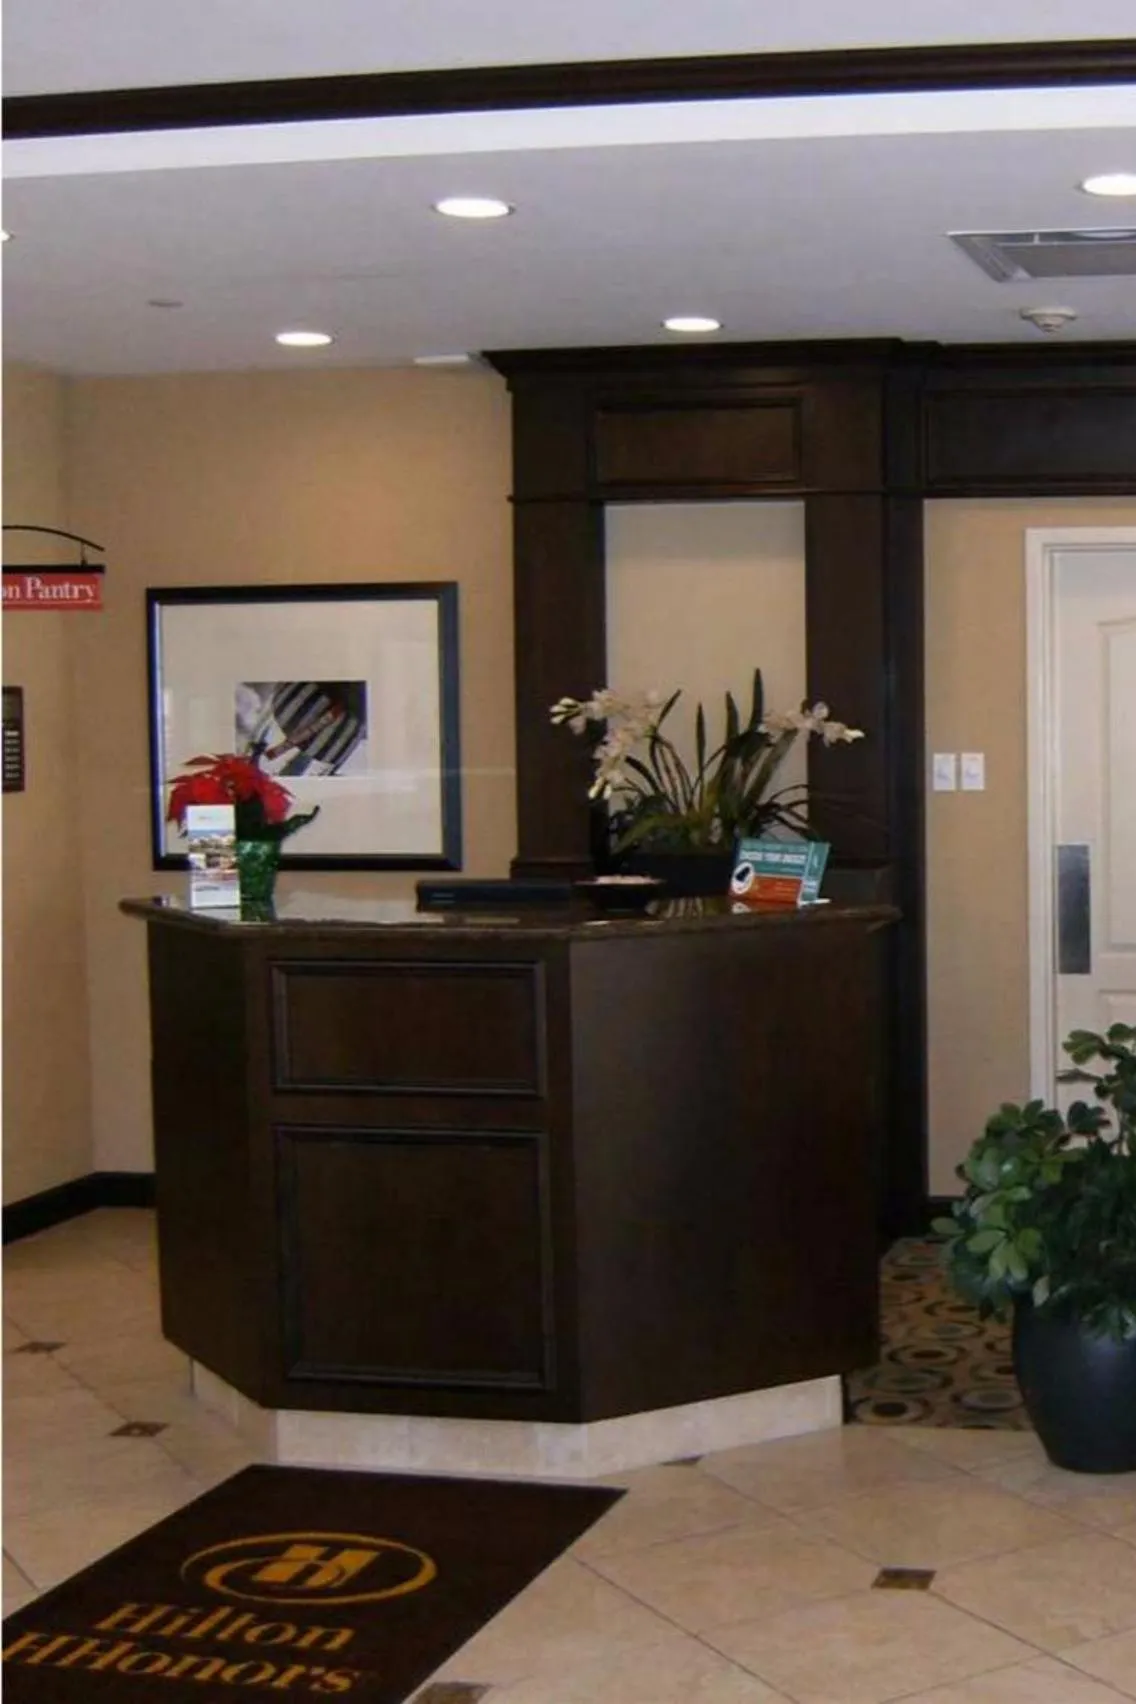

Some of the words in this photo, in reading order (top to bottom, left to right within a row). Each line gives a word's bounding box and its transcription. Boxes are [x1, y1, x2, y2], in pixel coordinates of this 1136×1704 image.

[26, 576, 95, 603] Pantry
[95, 1602, 355, 1650] Hilton
[2, 1631, 361, 1693] HHonors
